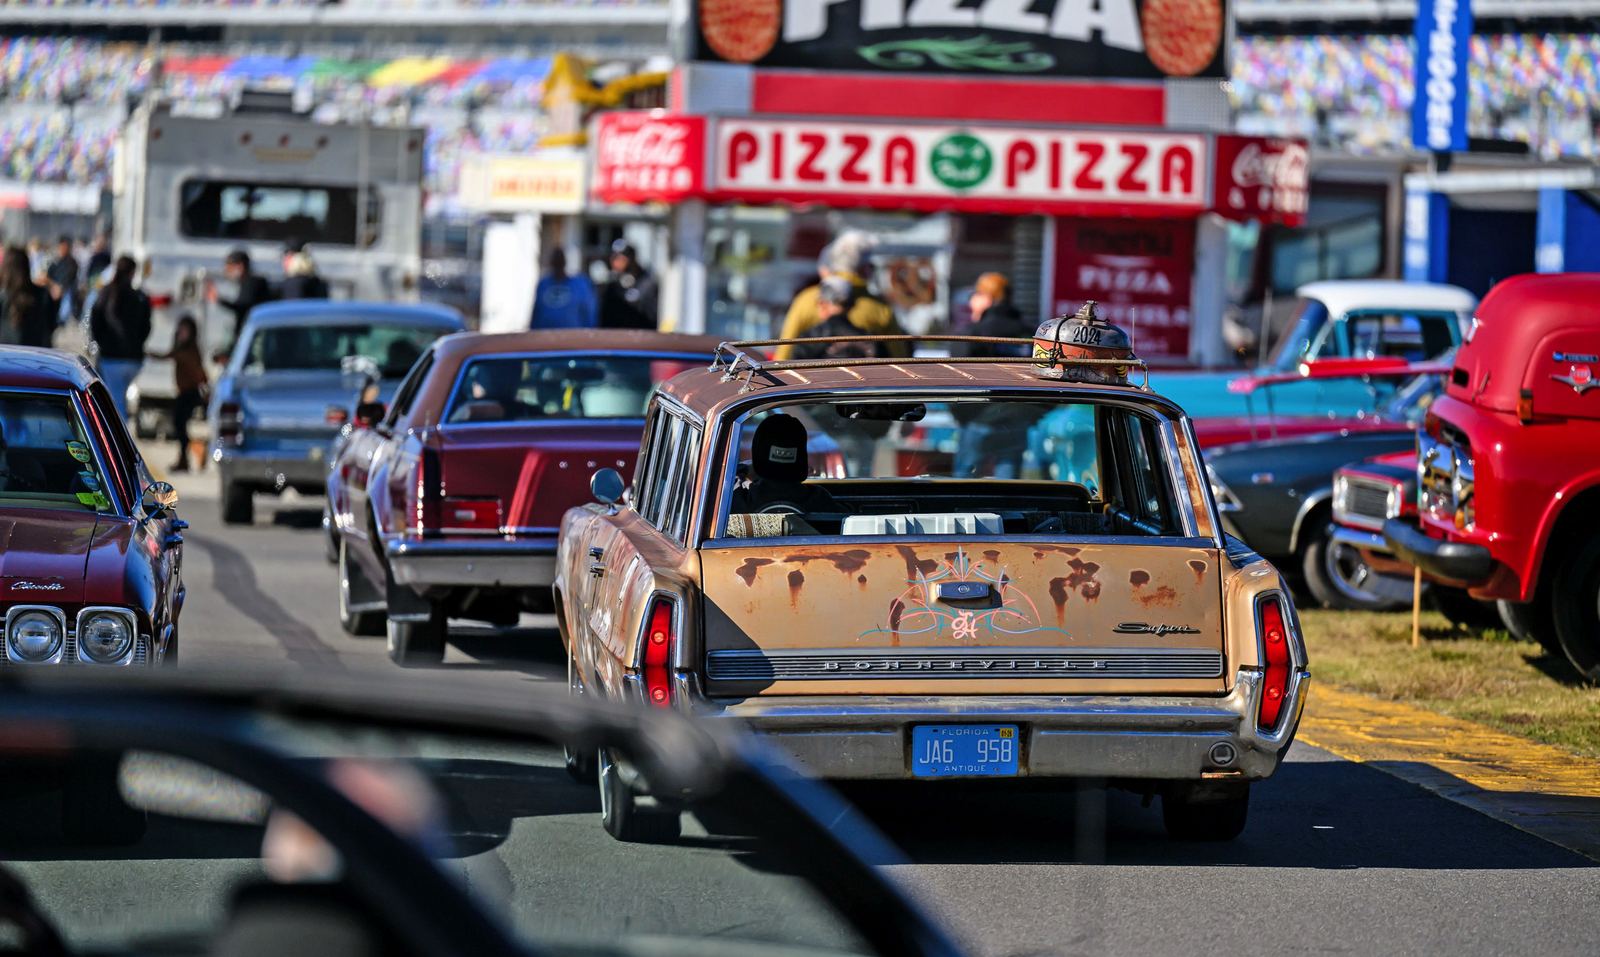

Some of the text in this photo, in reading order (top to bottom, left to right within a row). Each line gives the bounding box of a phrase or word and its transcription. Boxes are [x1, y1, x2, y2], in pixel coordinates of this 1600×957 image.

[728, 131, 916, 185] PIZZA
[1005, 139, 1194, 194] PIZZA
[1073, 326, 1102, 345] 2024
[823, 660, 1107, 671] BONNEVILLE
[942, 728, 989, 736] FLORIDA
[919, 739, 1012, 764] JA6 958
